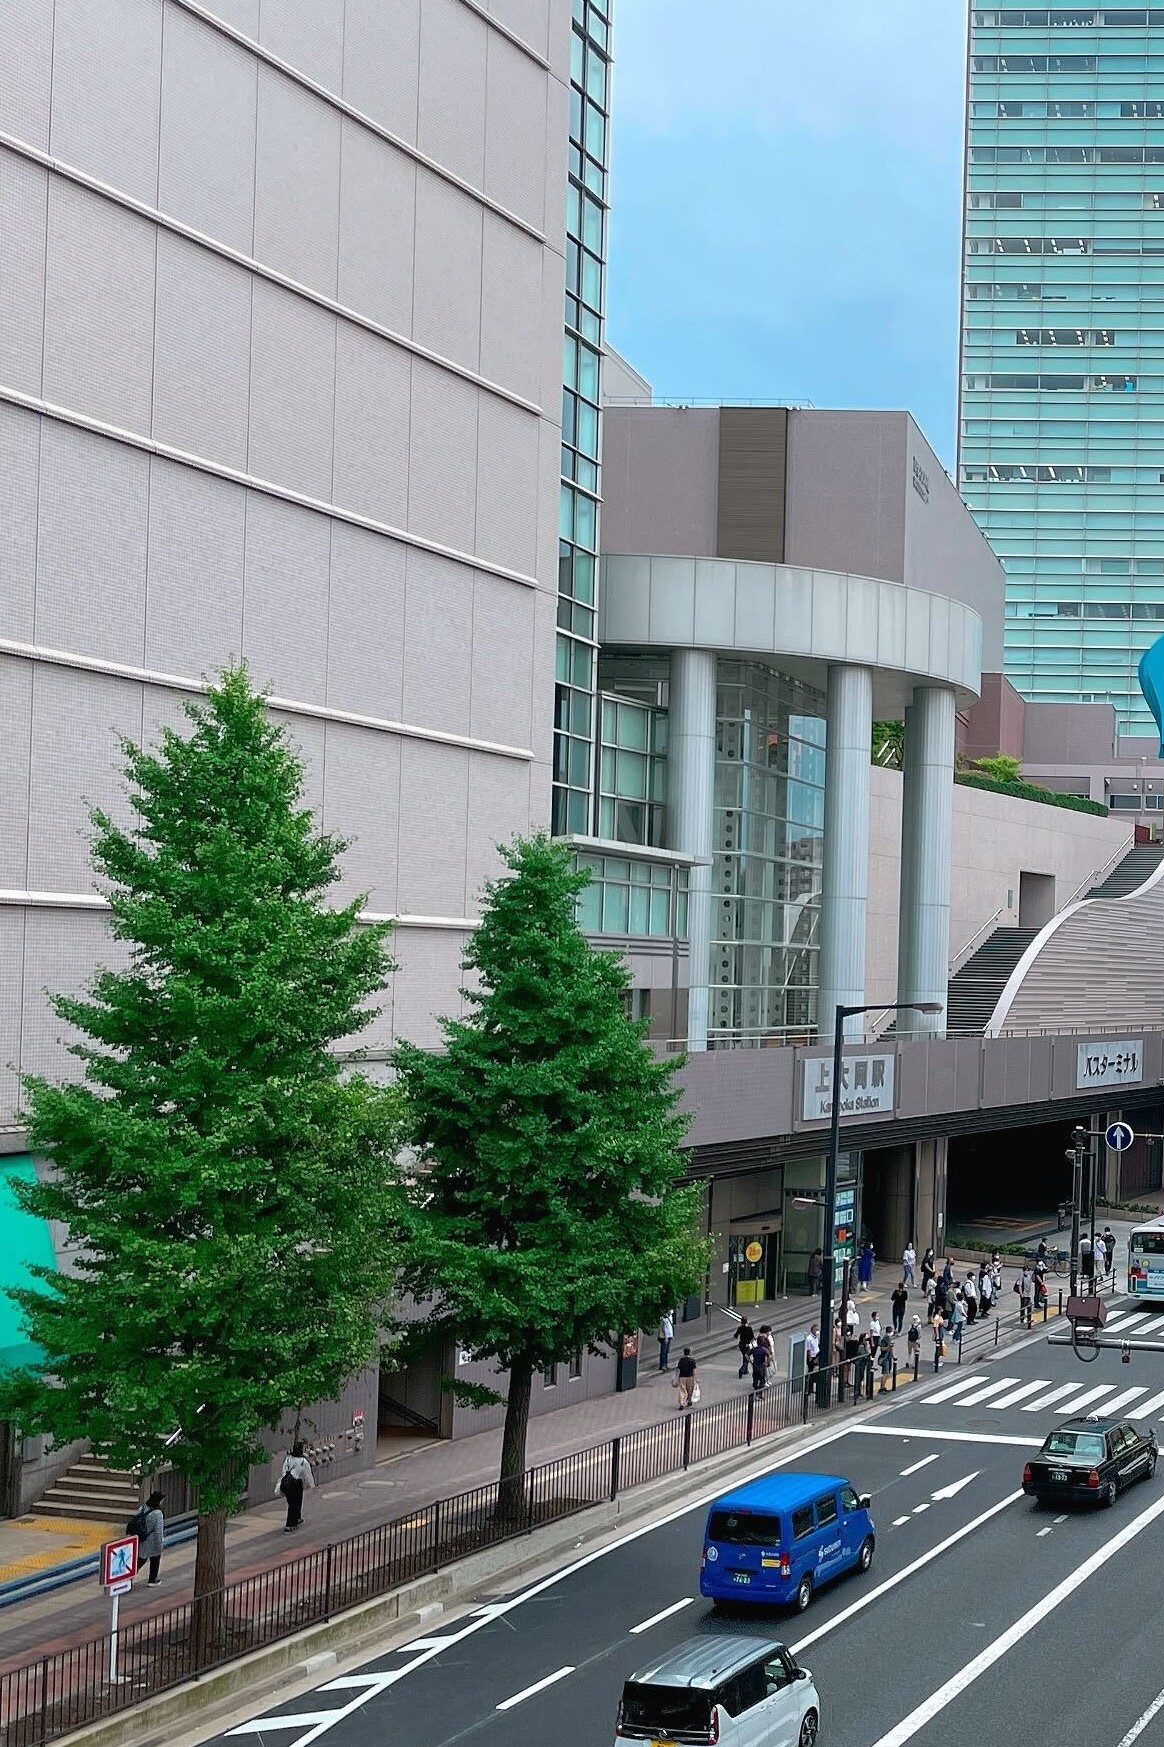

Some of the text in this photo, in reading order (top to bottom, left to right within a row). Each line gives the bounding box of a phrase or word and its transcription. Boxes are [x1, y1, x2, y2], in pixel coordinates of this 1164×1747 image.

[1083, 1052, 1138, 1078] バスターミナル
[855, 1095, 880, 1110] Station
